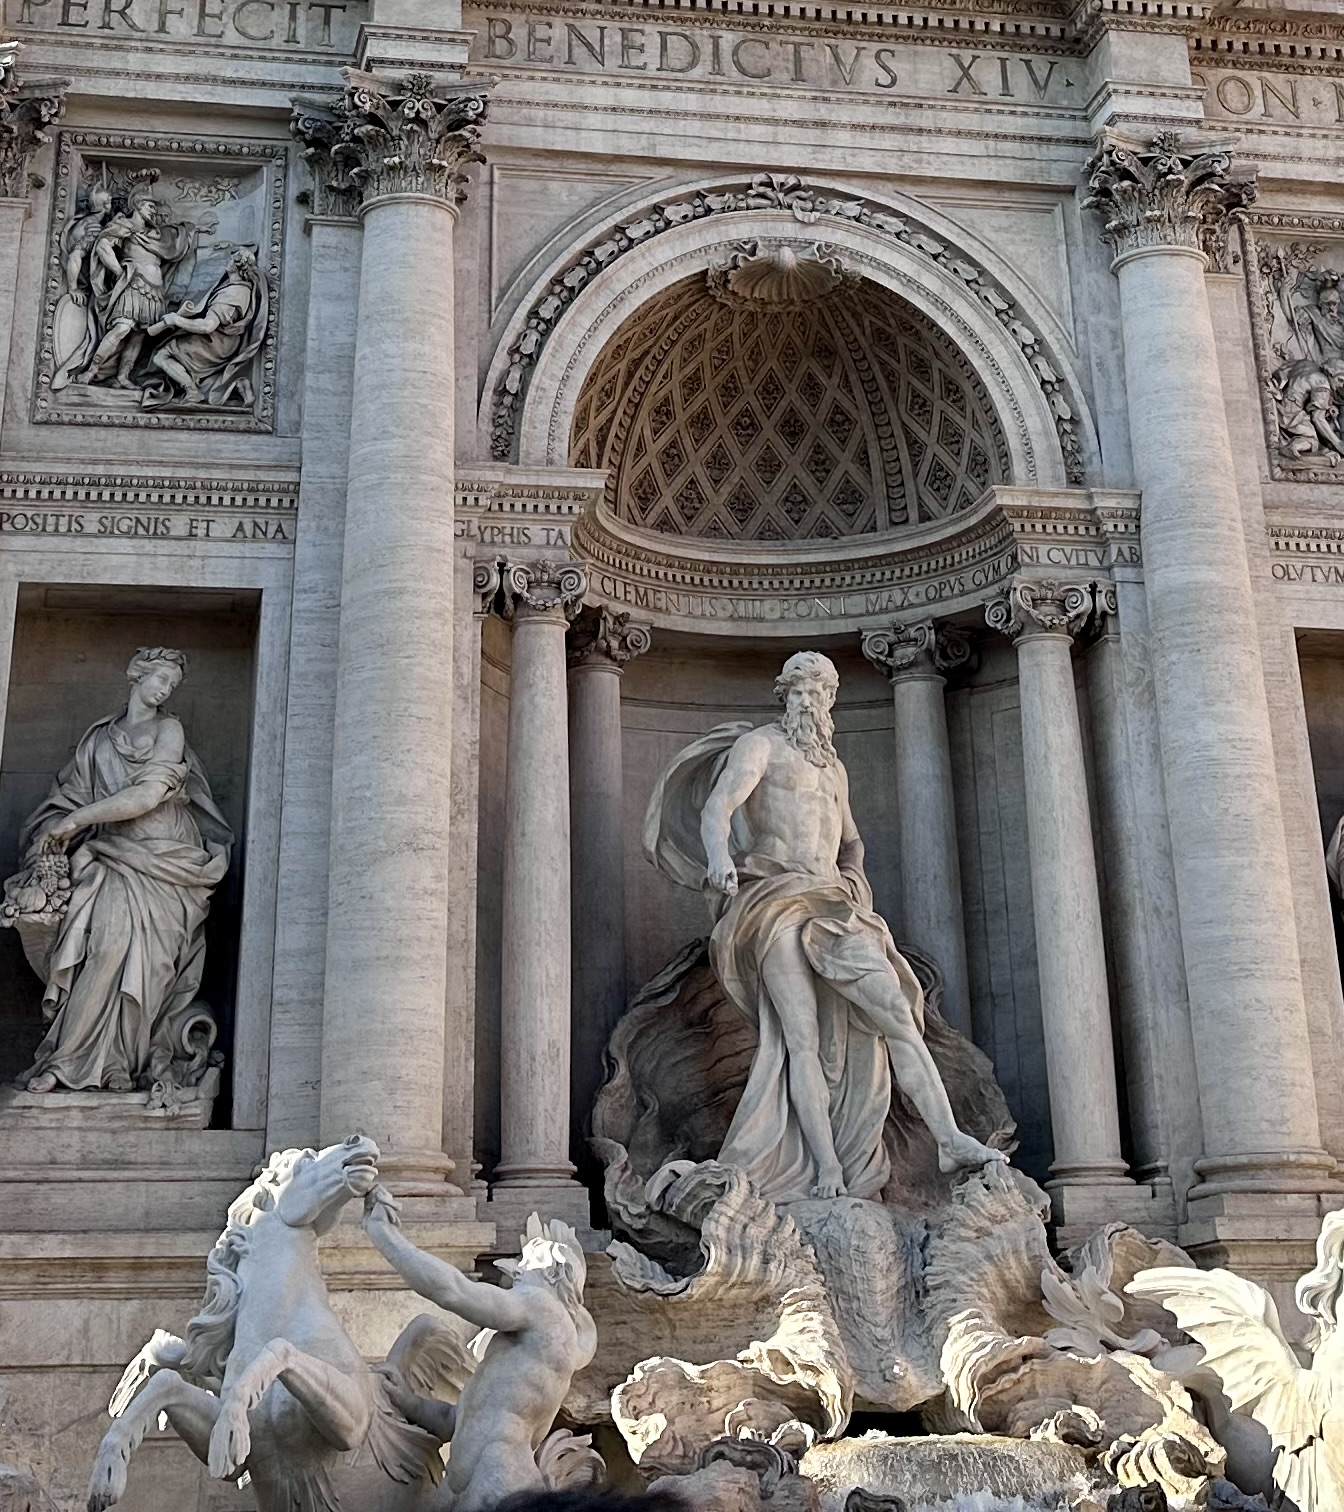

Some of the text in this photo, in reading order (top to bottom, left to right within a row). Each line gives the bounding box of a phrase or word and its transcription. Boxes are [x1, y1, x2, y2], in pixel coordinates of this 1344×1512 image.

[483, 16, 898, 89] BENEDICTVS
[97, 515, 172, 537] SIGNIS
[187, 517, 216, 538] ET
[231, 519, 287, 539] ANA
[454, 519, 571, 547] GLYPHIS TA
[924, 575, 965, 602] OPVS
[972, 560, 1002, 587] CVM
